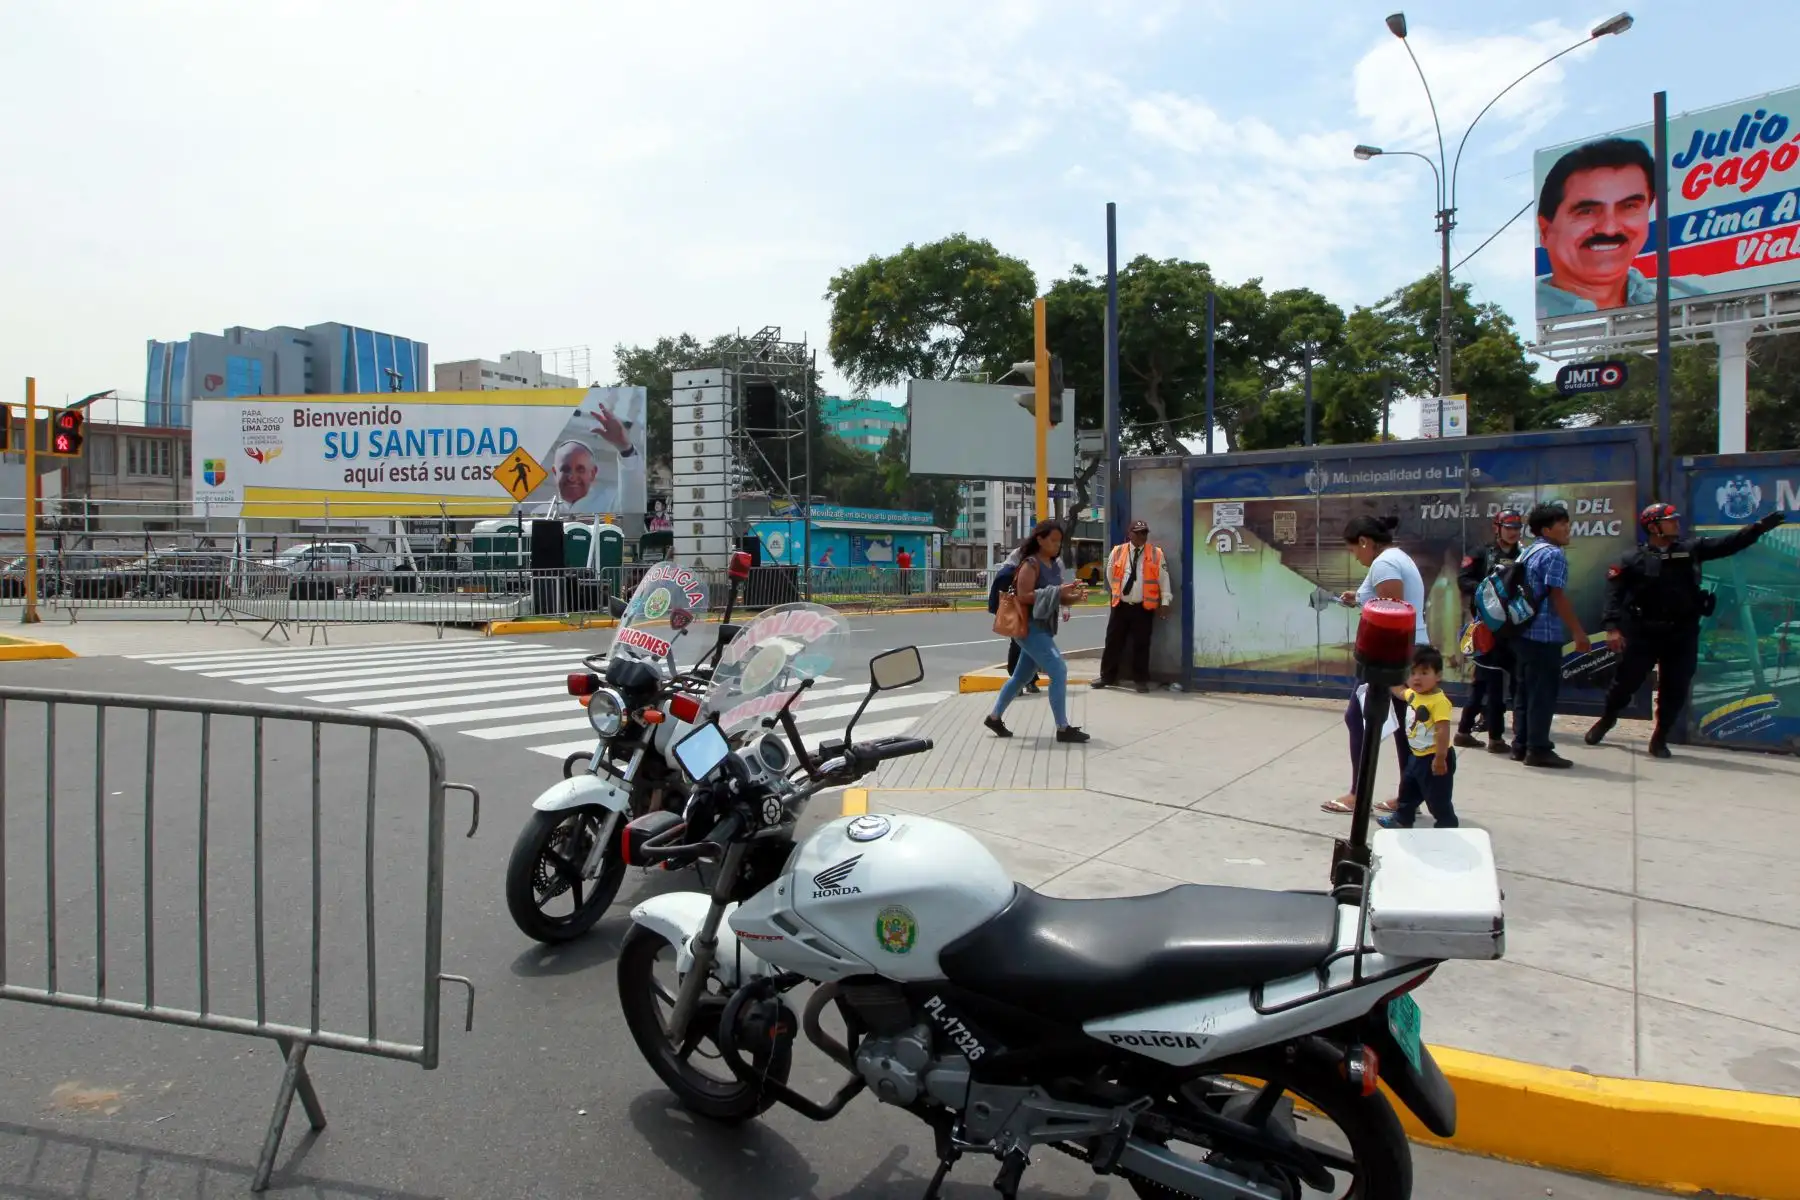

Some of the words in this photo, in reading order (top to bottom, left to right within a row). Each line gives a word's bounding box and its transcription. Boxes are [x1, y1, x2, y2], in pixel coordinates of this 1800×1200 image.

[1672, 109, 1788, 169] Julio
[1681, 133, 1800, 200] Gagó
[1681, 206, 1764, 243] Lima
[1771, 192, 1800, 222] A
[1565, 368, 1600, 384] JMT
[293, 405, 402, 428] Bienvenido
[324, 430, 359, 459] SU
[369, 427, 518, 458] SANTIDAD
[344, 463, 384, 488] aquí
[389, 462, 428, 482] está
[434, 466, 455, 481] su
[1332, 469, 1421, 484] Municipalidad
[1426, 467, 1442, 478] de
[1420, 500, 1480, 519] TÚNEL
[1576, 498, 1614, 514] DEL
[639, 565, 704, 608] POLICIA
[812, 886, 862, 898] HONDA
[923, 994, 986, 1060] PL-17326
[1109, 1034, 1202, 1049] POLICIA
